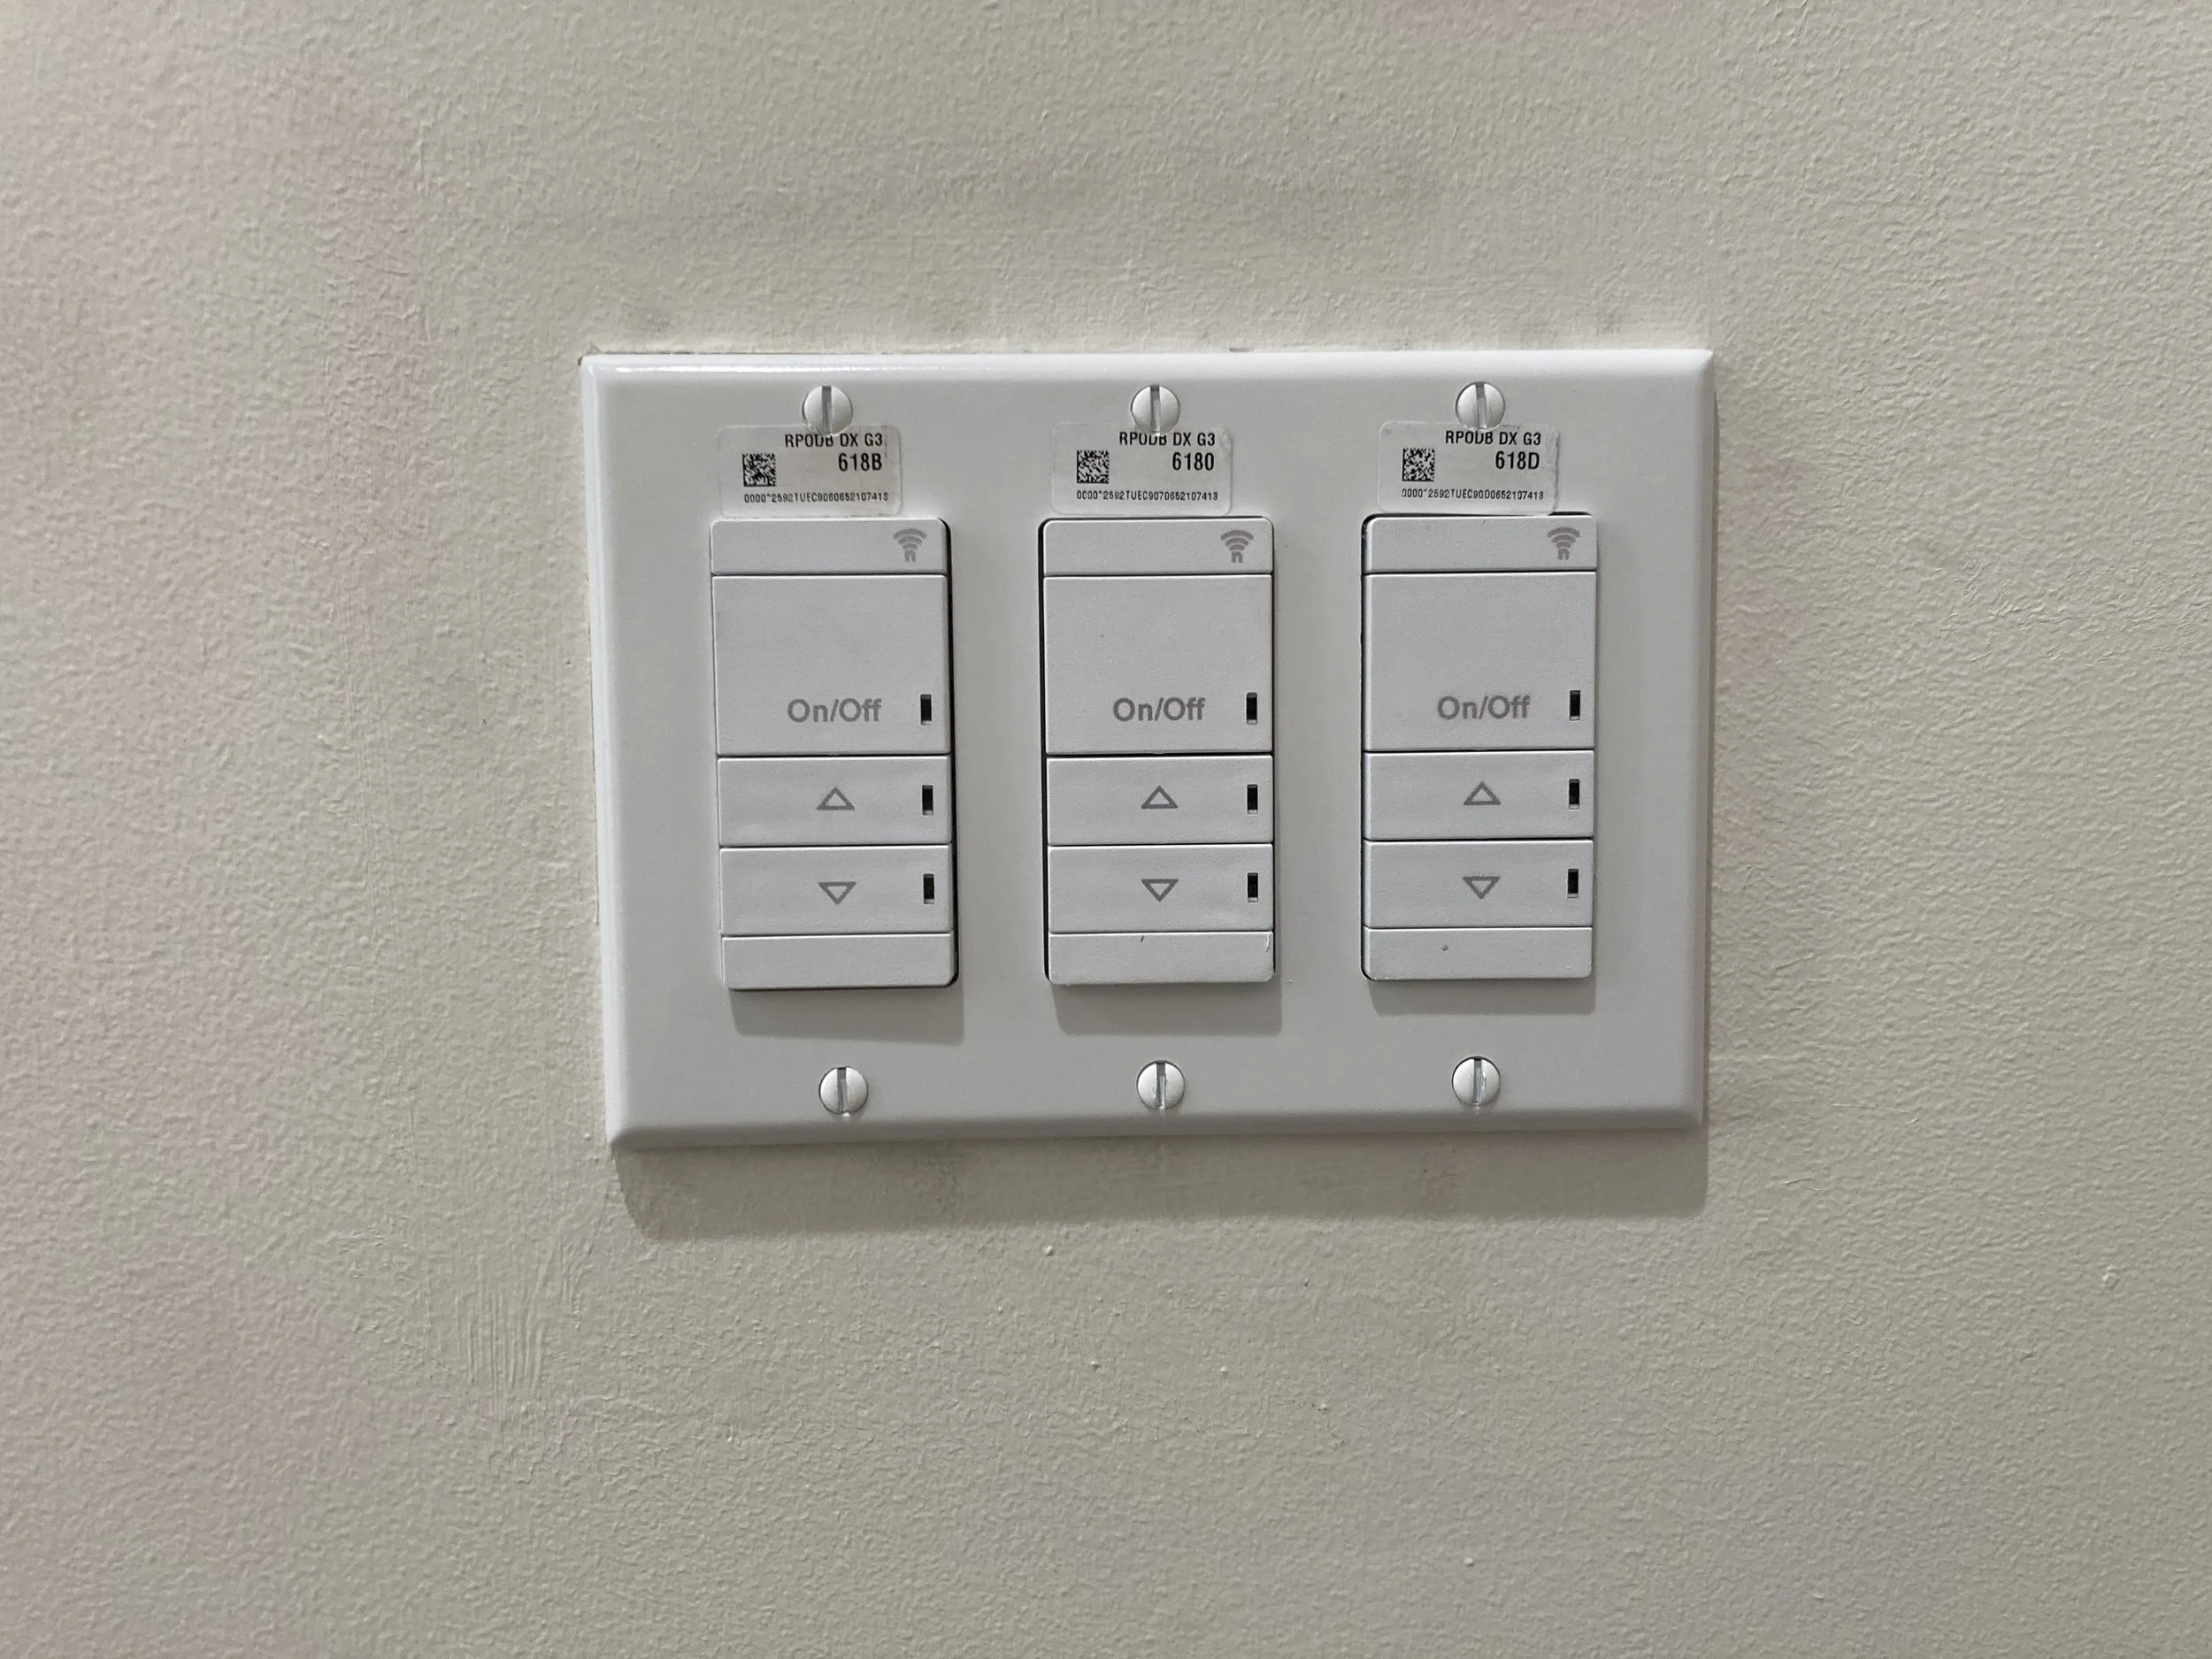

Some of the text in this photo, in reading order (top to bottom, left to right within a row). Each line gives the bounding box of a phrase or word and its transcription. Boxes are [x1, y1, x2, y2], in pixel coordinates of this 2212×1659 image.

[784, 432, 883, 448] RPODB DX G3
[1118, 431, 1216, 447] RPODB DX G3
[1445, 430, 1541, 446] RPODB DX G3
[838, 452, 882, 472] 618B
[1171, 451, 1215, 471] 6180
[1494, 450, 1540, 470] 618D
[787, 698, 882, 723] On/Off
[1113, 697, 1205, 722] On/Off
[1437, 695, 1531, 720] On/Off
